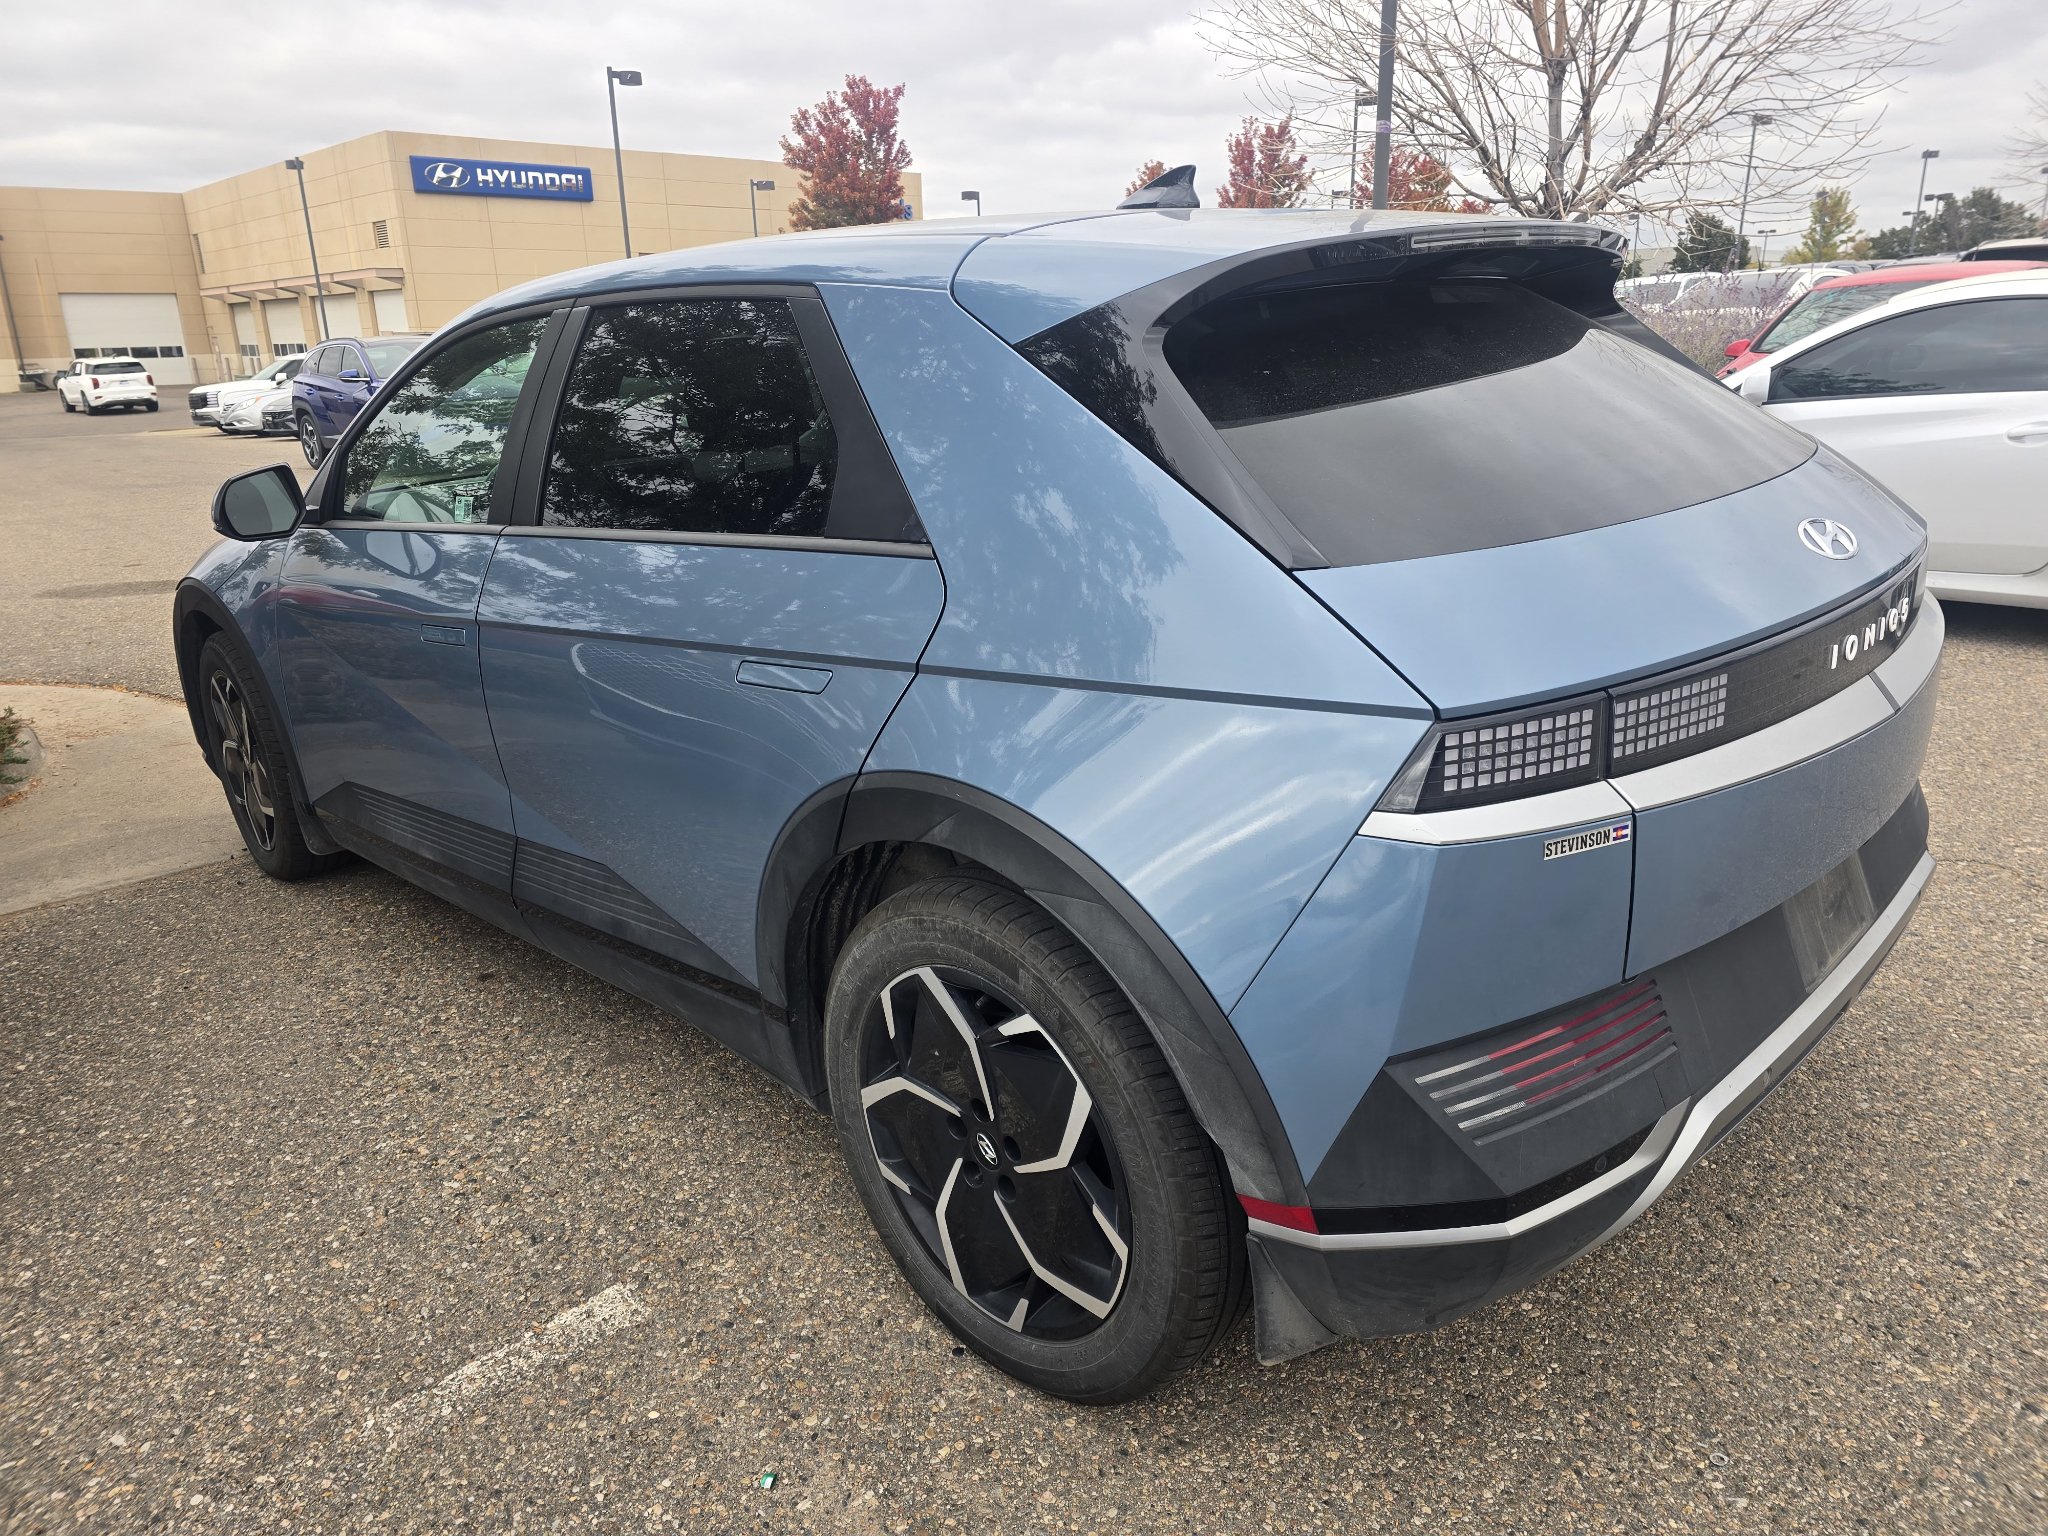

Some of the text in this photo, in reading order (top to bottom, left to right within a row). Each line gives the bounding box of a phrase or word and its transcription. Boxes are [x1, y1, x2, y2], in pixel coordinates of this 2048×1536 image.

[476, 168, 583, 192] HYUNDAI
[1830, 597, 1909, 669] IONIQ 5
[1545, 829, 1610, 857] STEVINSON
